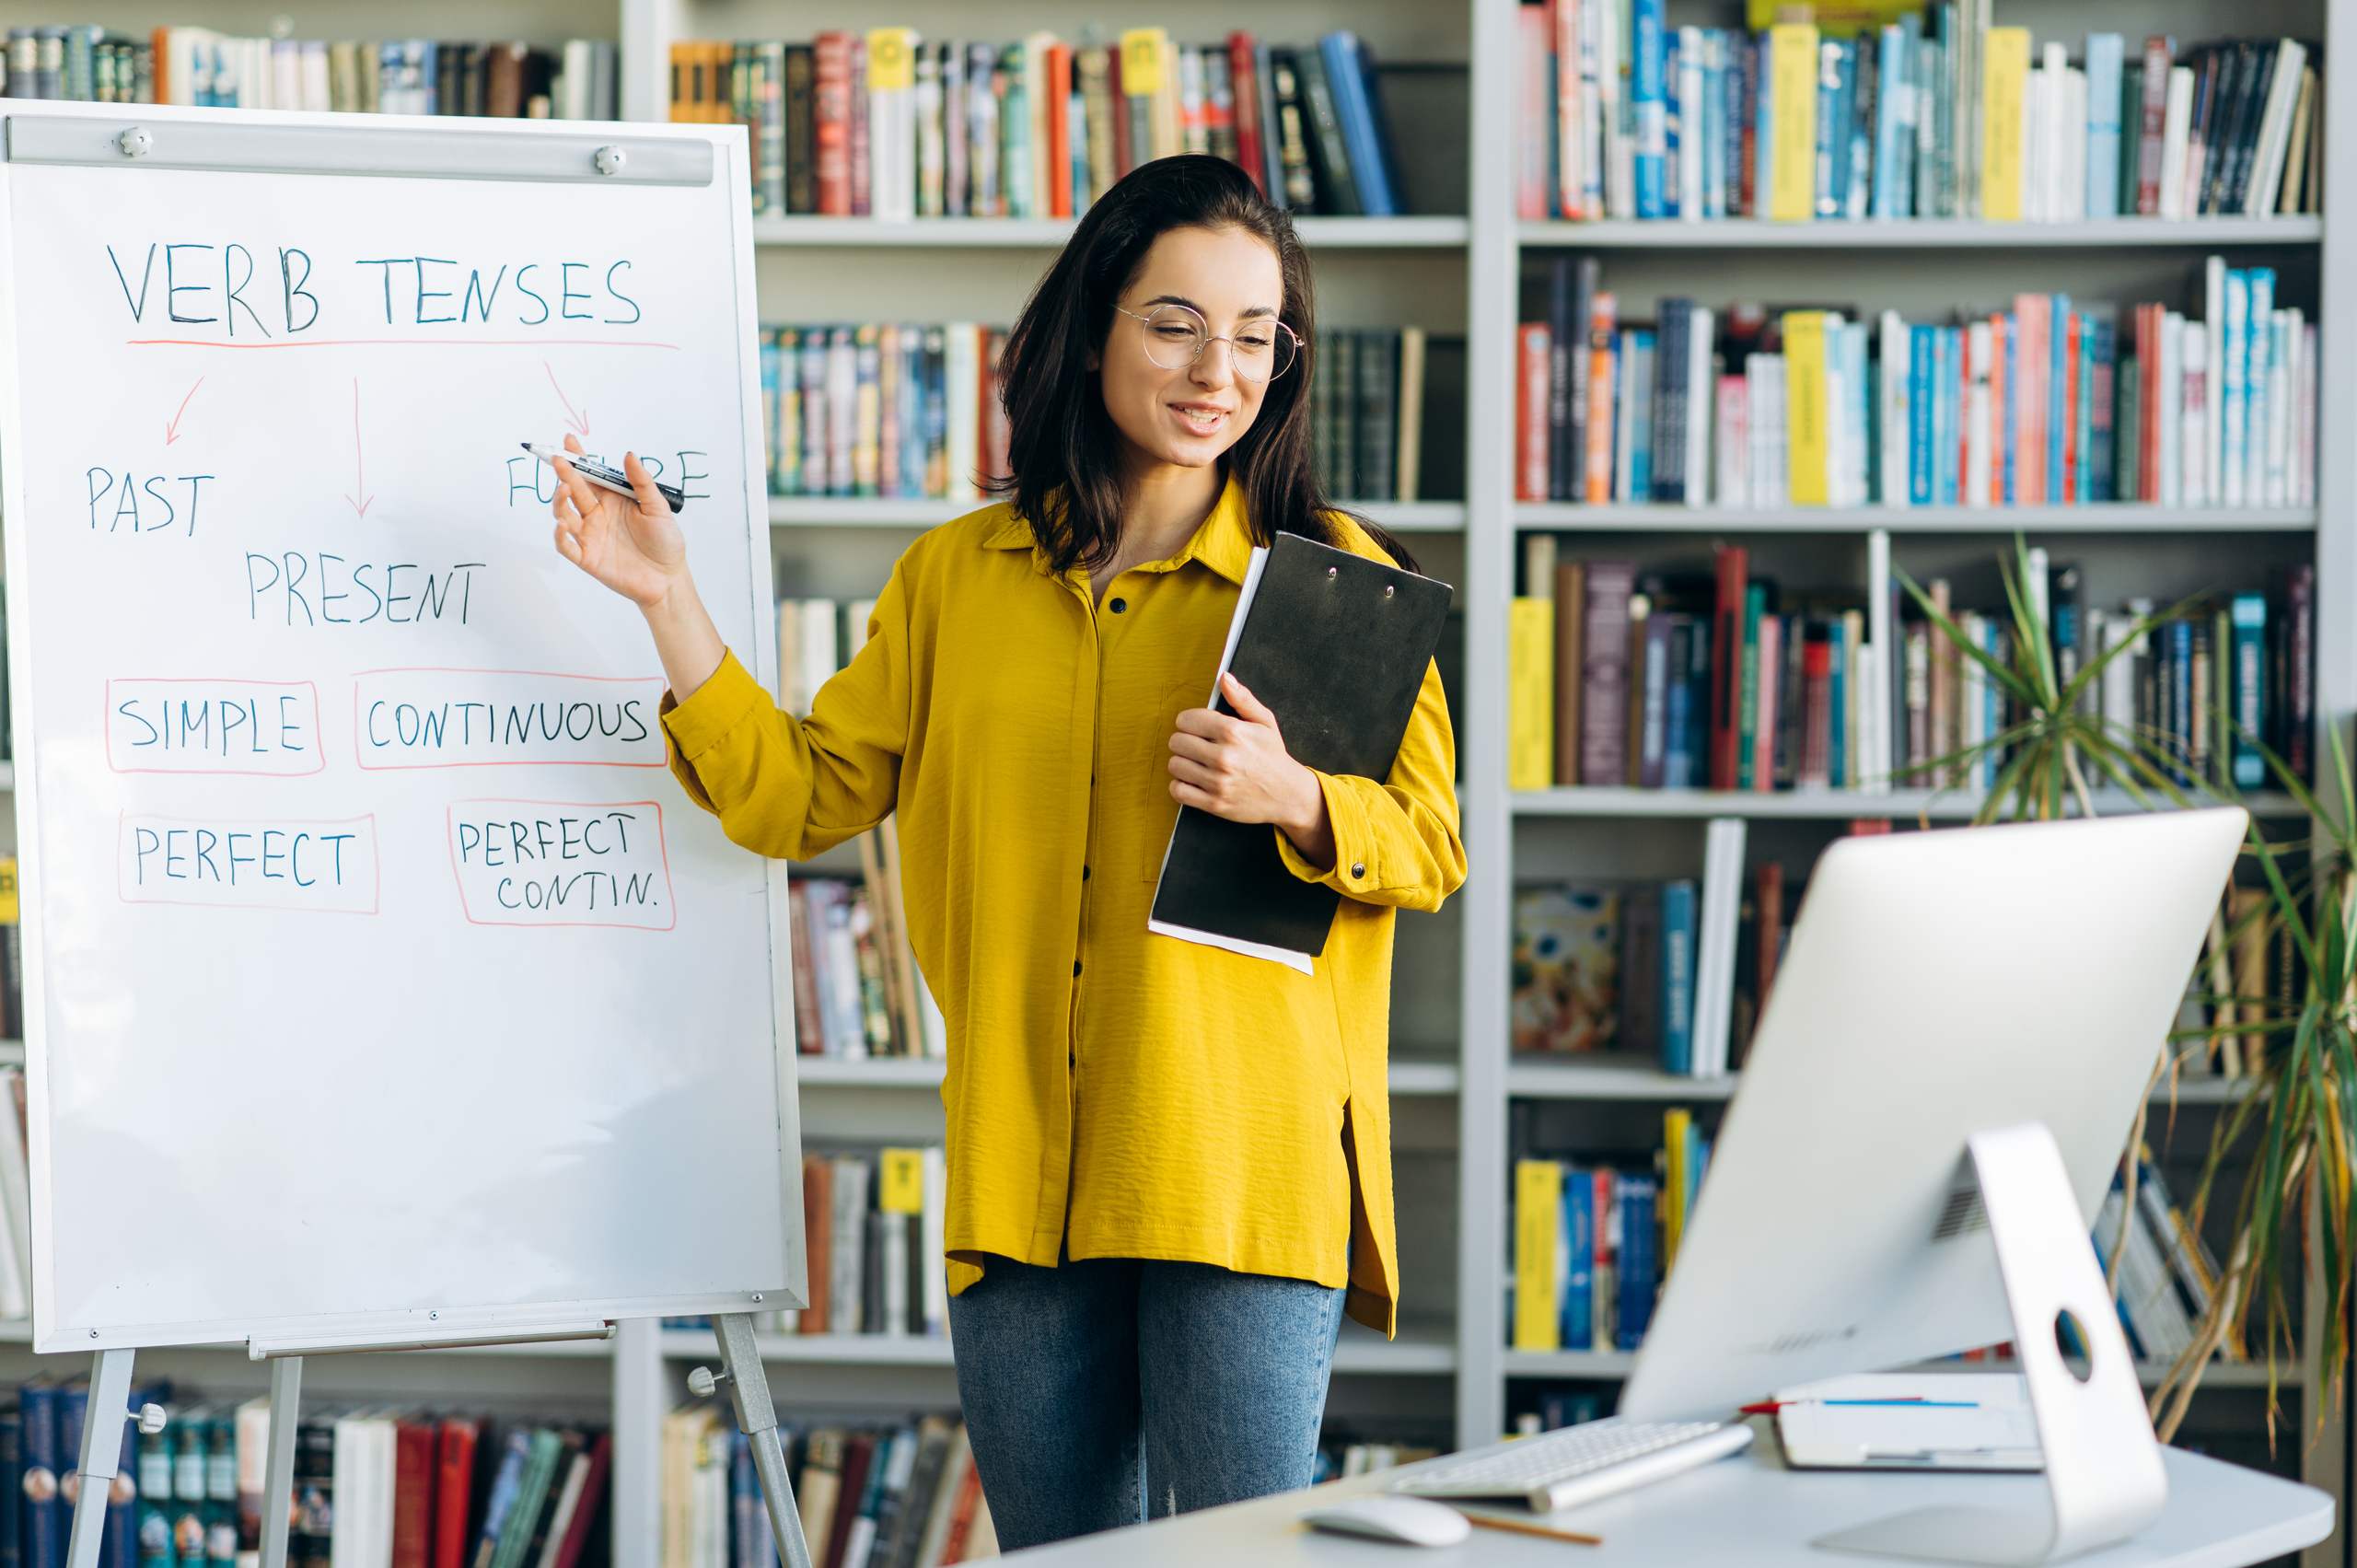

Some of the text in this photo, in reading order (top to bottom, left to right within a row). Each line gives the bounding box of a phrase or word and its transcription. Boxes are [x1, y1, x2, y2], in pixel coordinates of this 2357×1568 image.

[107, 243, 641, 338] VERB TENSES
[87, 467, 215, 537] PAST
[246, 552, 486, 626] PRESENT
[119, 696, 304, 756] SIMPLE
[369, 701, 647, 749] CONTINUOUS
[136, 828, 355, 887] PERFECT
[459, 813, 635, 866] PERFECT
[498, 872, 657, 910] CONTIN.
